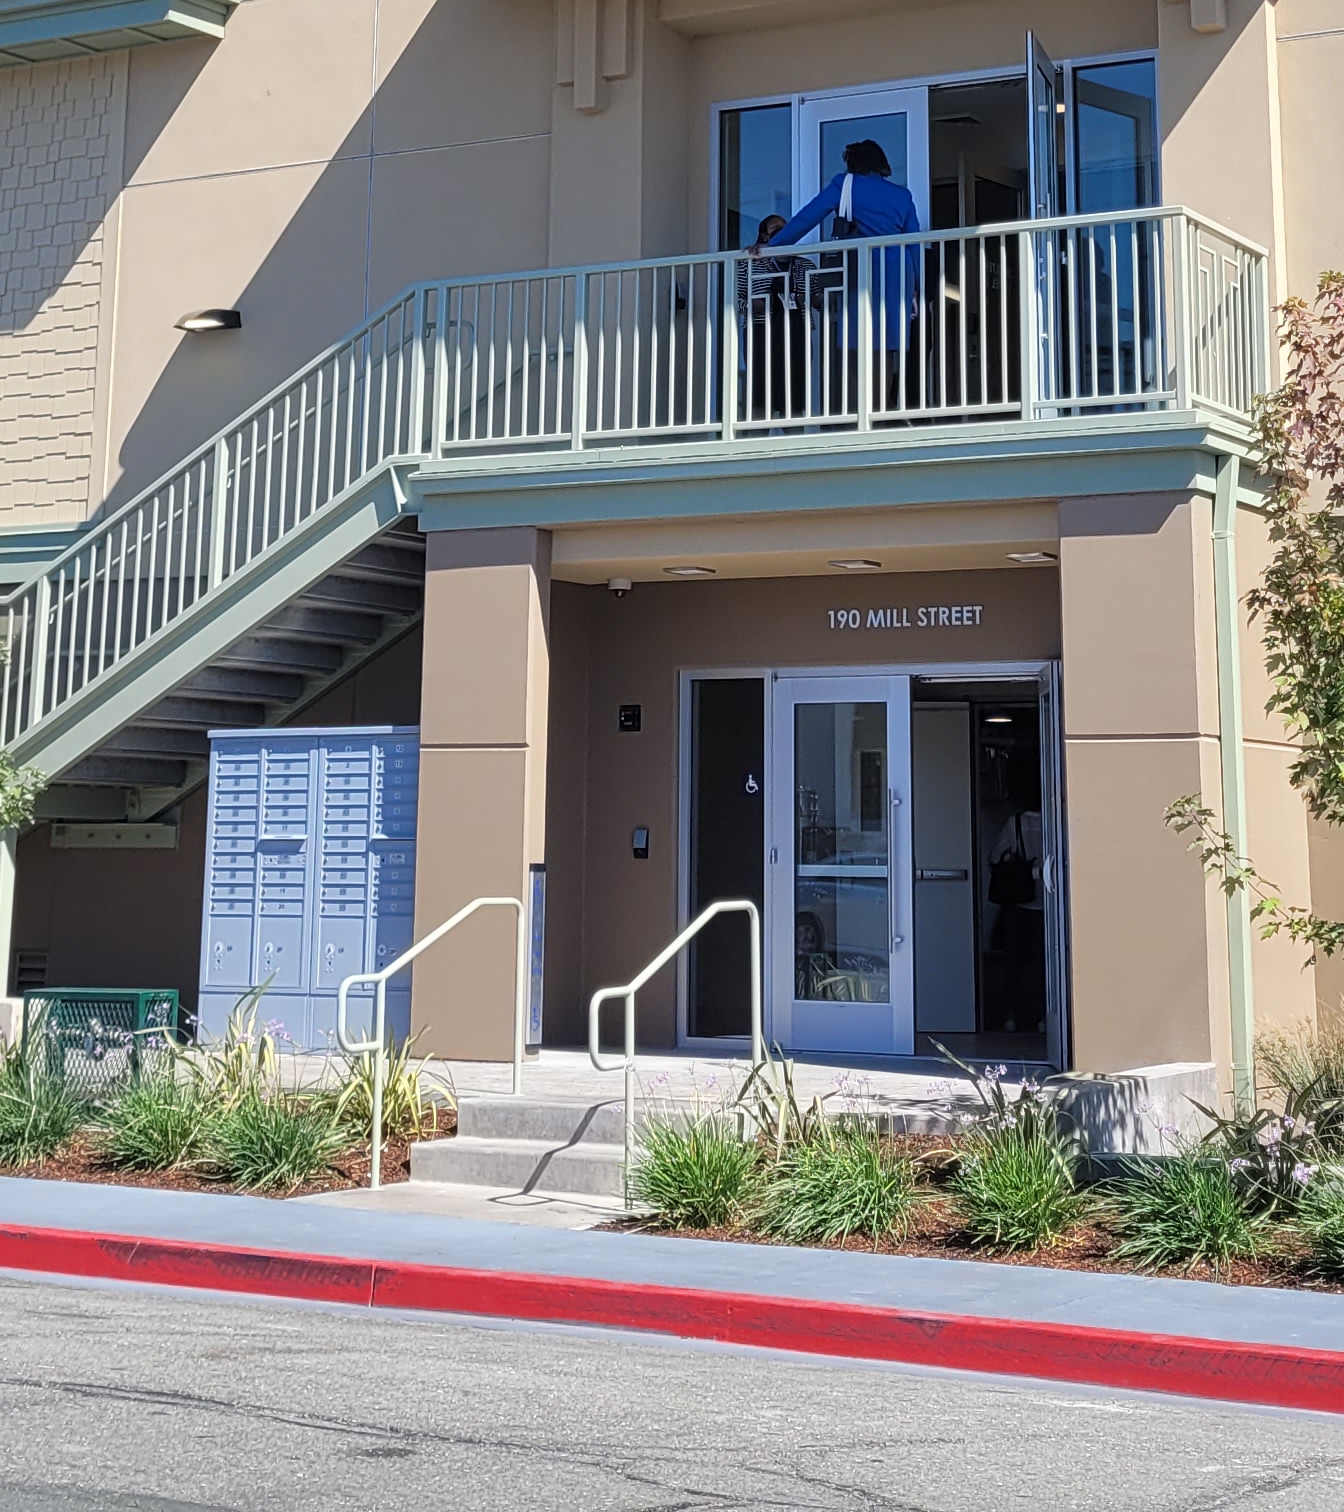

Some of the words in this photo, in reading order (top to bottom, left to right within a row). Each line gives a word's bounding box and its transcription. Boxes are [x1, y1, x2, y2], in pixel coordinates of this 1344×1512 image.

[827, 608, 861, 630] 190
[865, 607, 912, 629] MILL
[916, 605, 983, 628] STREET
